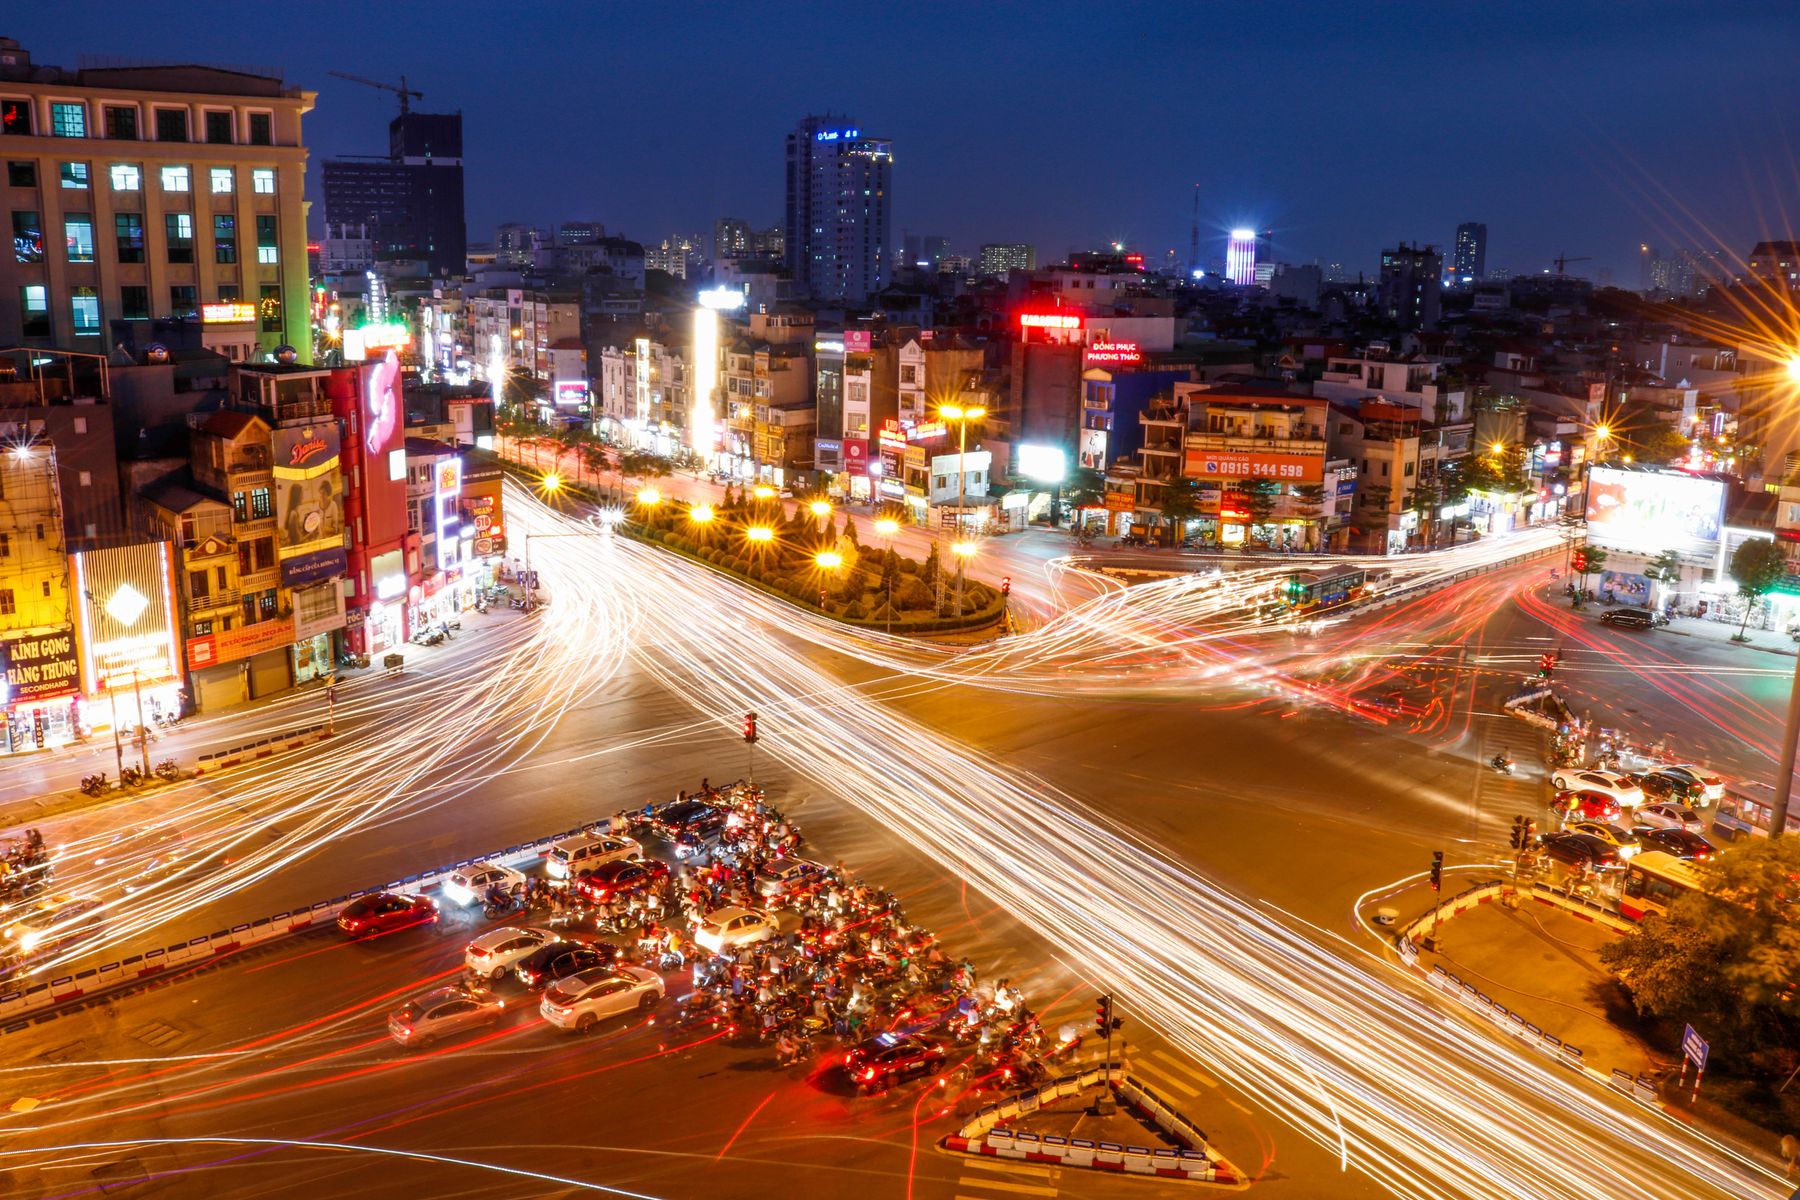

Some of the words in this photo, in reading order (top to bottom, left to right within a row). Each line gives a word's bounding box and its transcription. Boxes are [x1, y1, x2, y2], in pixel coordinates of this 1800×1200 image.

[1116, 343, 1136, 352] PHỤC
[1088, 352, 1118, 360] PHƯƠNG
[1220, 462, 1249, 474] 0915
[1253, 464, 1276, 476] 344
[1280, 465, 1303, 477] 598
[11, 639, 39, 661] KÍNH
[41, 636, 70, 659] GỌNG
[7, 664, 40, 685] HÀNG
[41, 658, 77, 680] THÙNG
[20, 680, 69, 694] SECONDHAND
